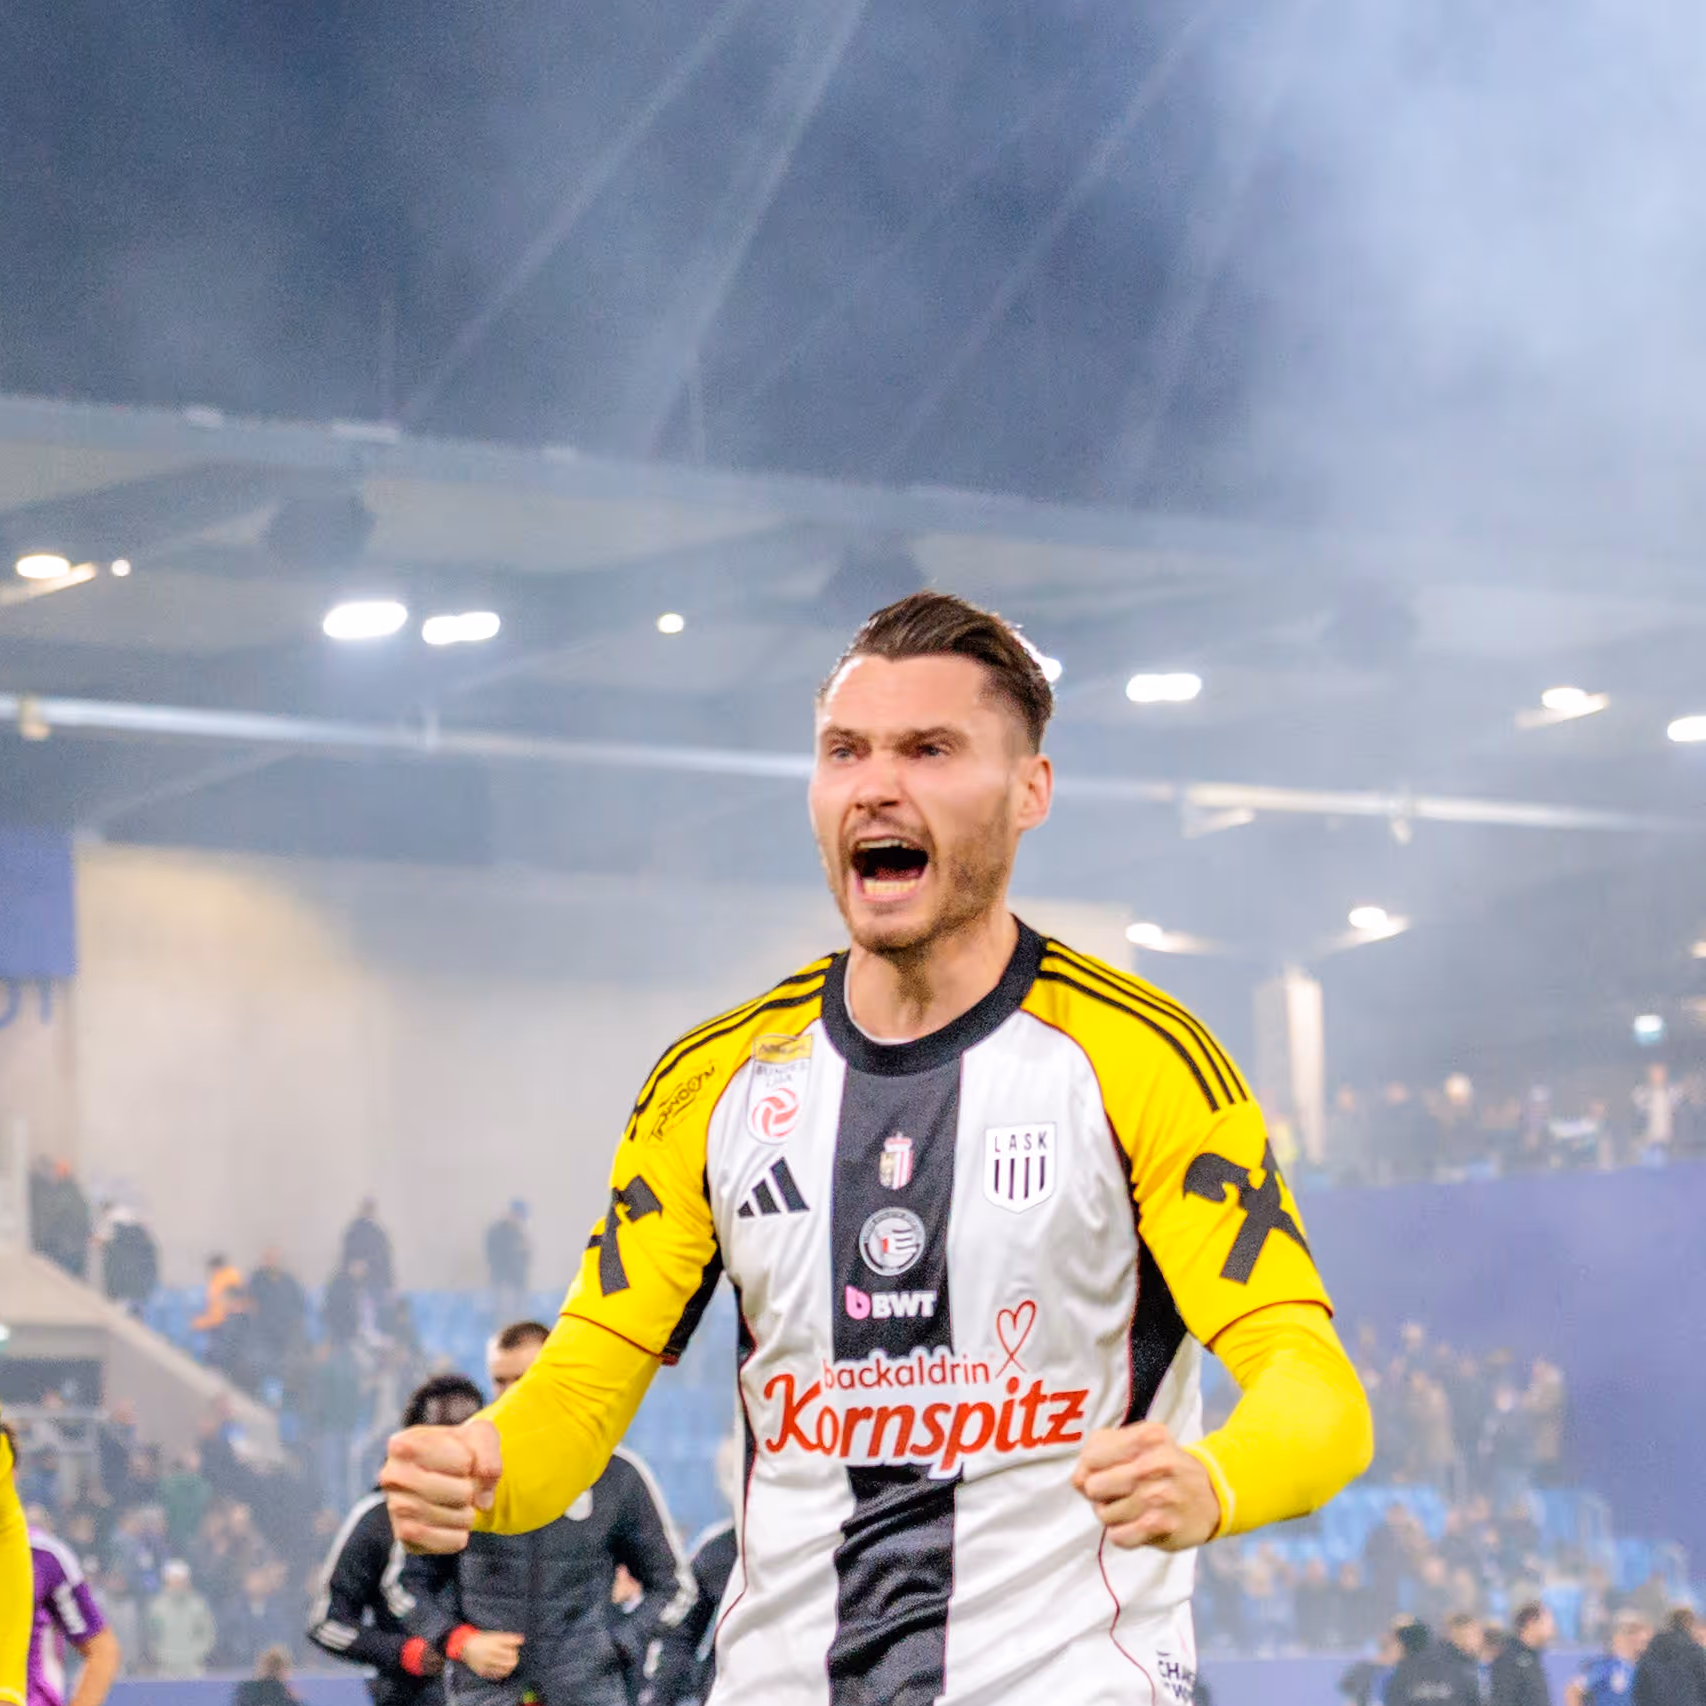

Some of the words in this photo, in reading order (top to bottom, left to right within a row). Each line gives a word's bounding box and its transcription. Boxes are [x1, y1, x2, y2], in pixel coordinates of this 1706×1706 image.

[994, 1131, 1048, 1153] LASK
[871, 1291, 937, 1319] BWT
[822, 1356, 989, 1389] backaldrin
[763, 1373, 1090, 1472] Kornspitz
